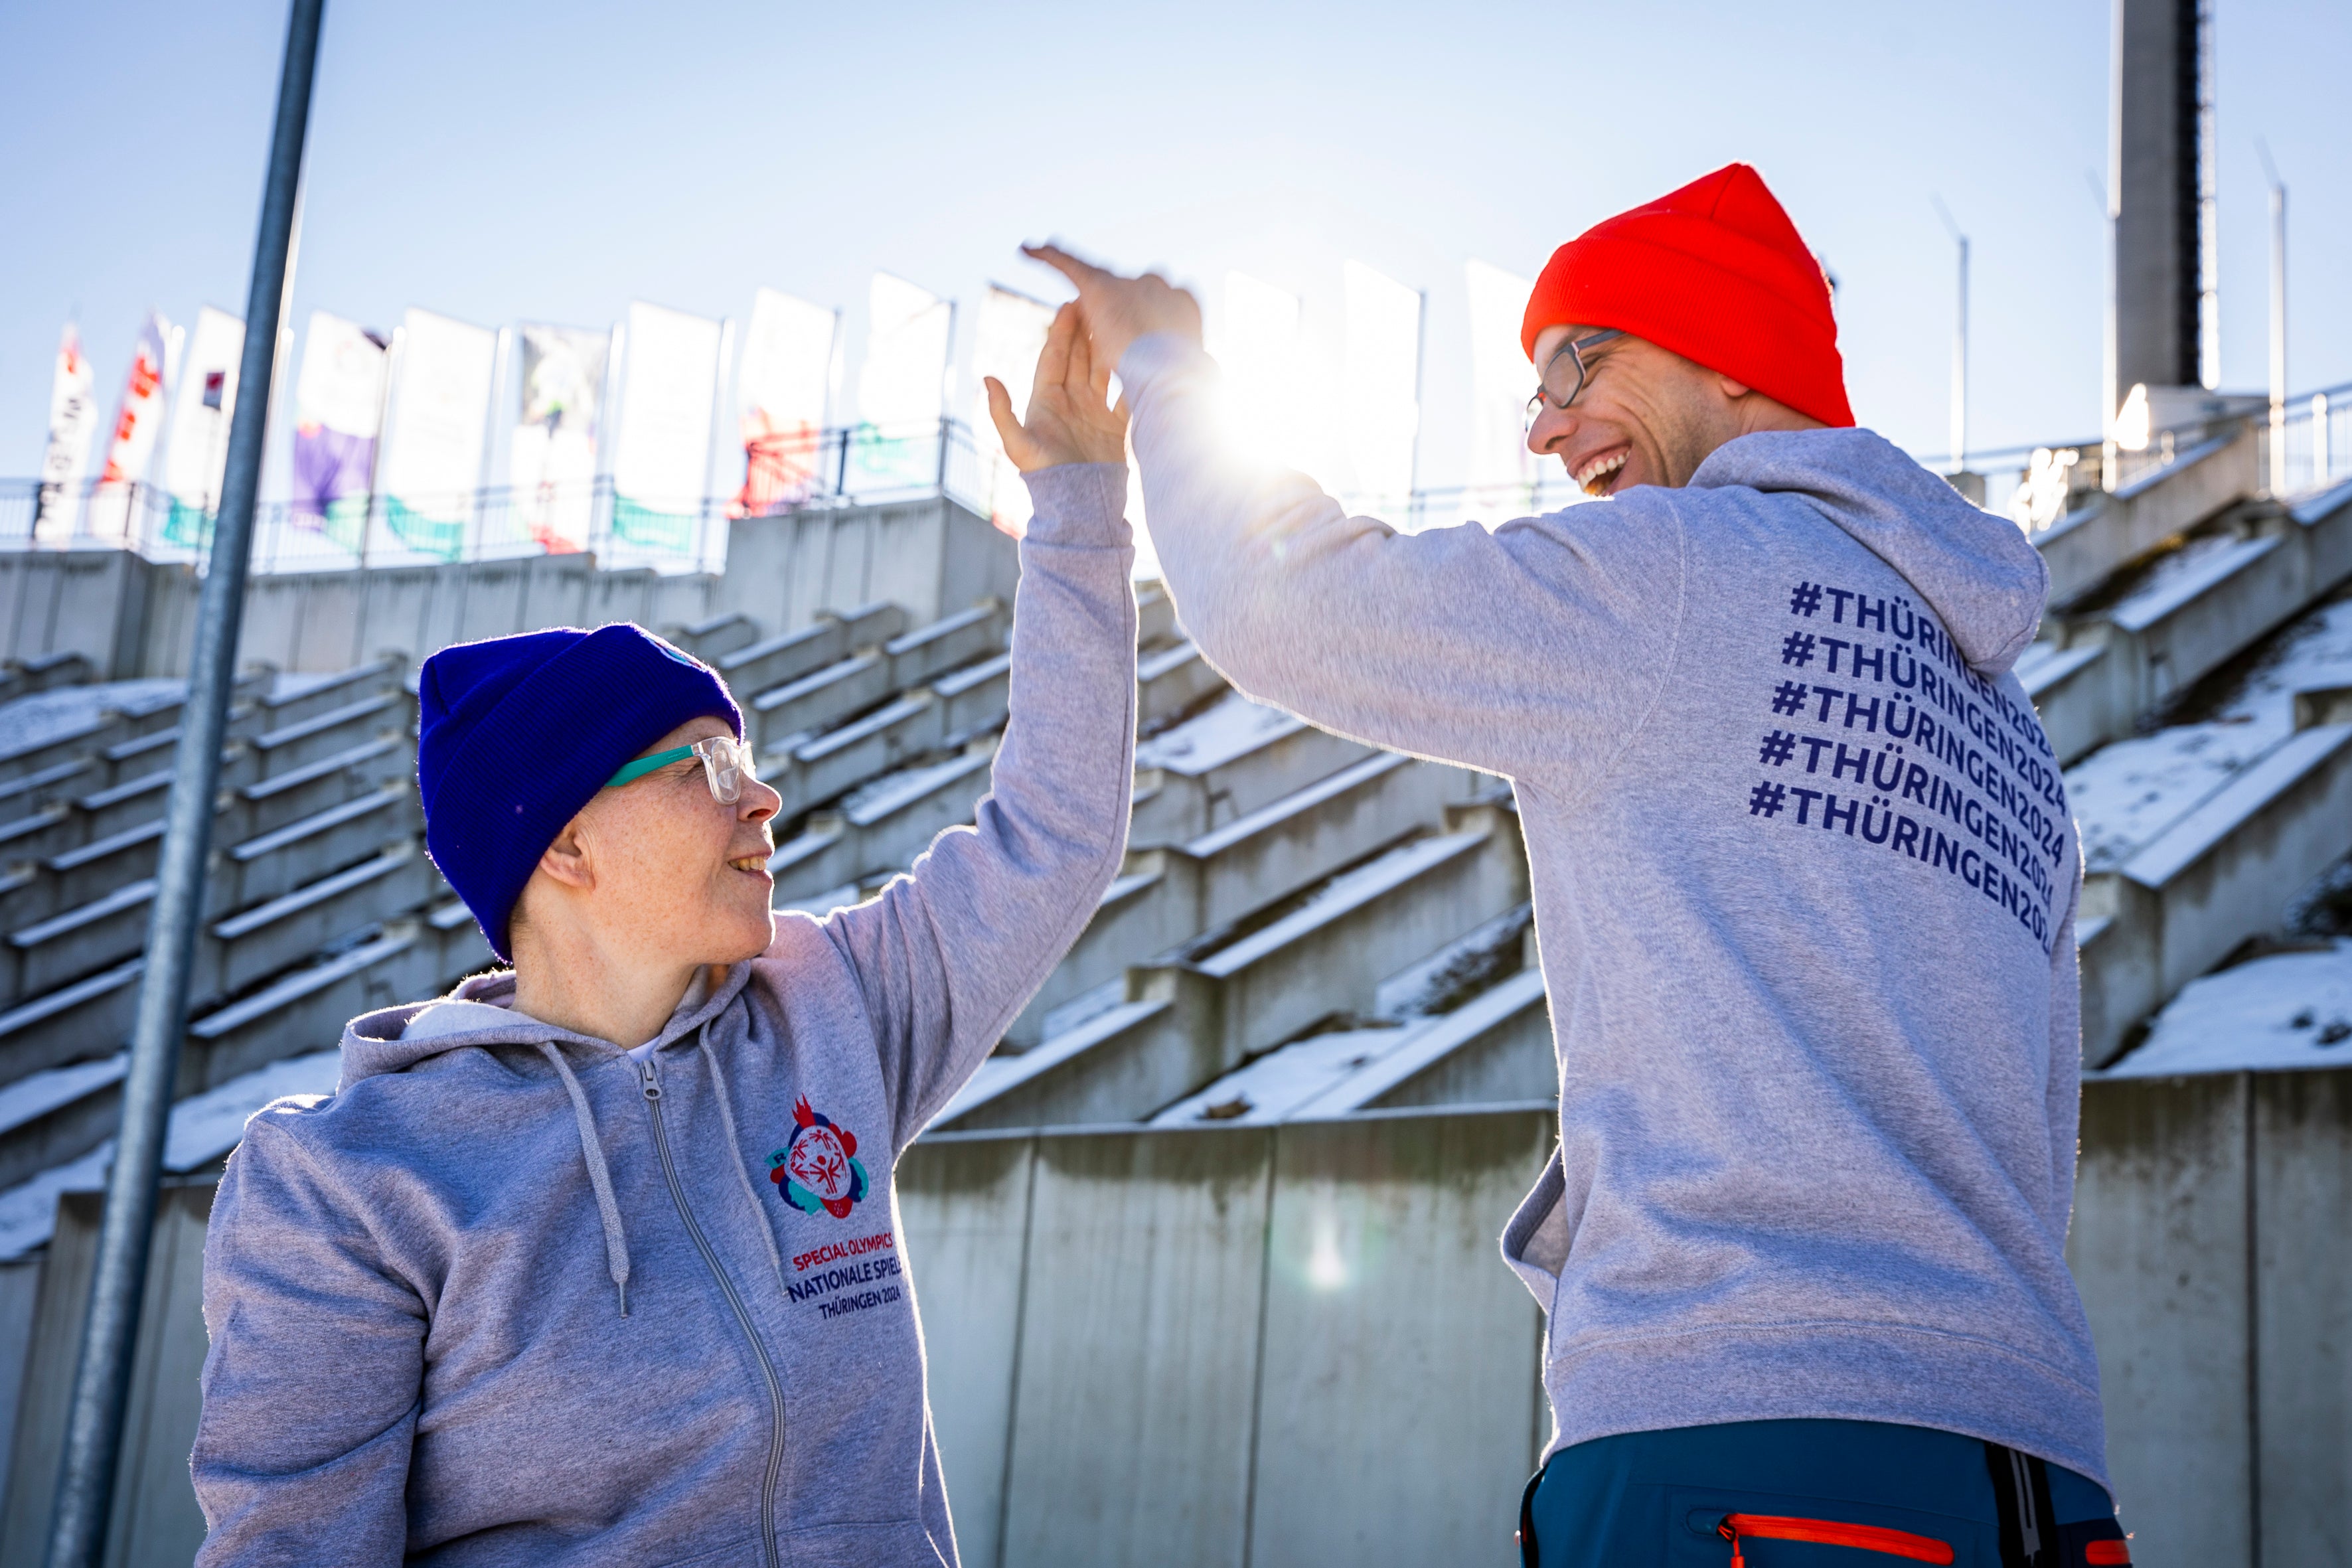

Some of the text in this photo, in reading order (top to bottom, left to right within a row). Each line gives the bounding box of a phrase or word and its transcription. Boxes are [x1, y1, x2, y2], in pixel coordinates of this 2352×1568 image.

[1772, 680, 2065, 868] #THÜRINGEN2024
[793, 1232, 893, 1271] SPECIAL OLYMPICS
[787, 1262, 874, 1303] NATIONALE
[818, 1285, 902, 1320] THÜRINGEN 2024
